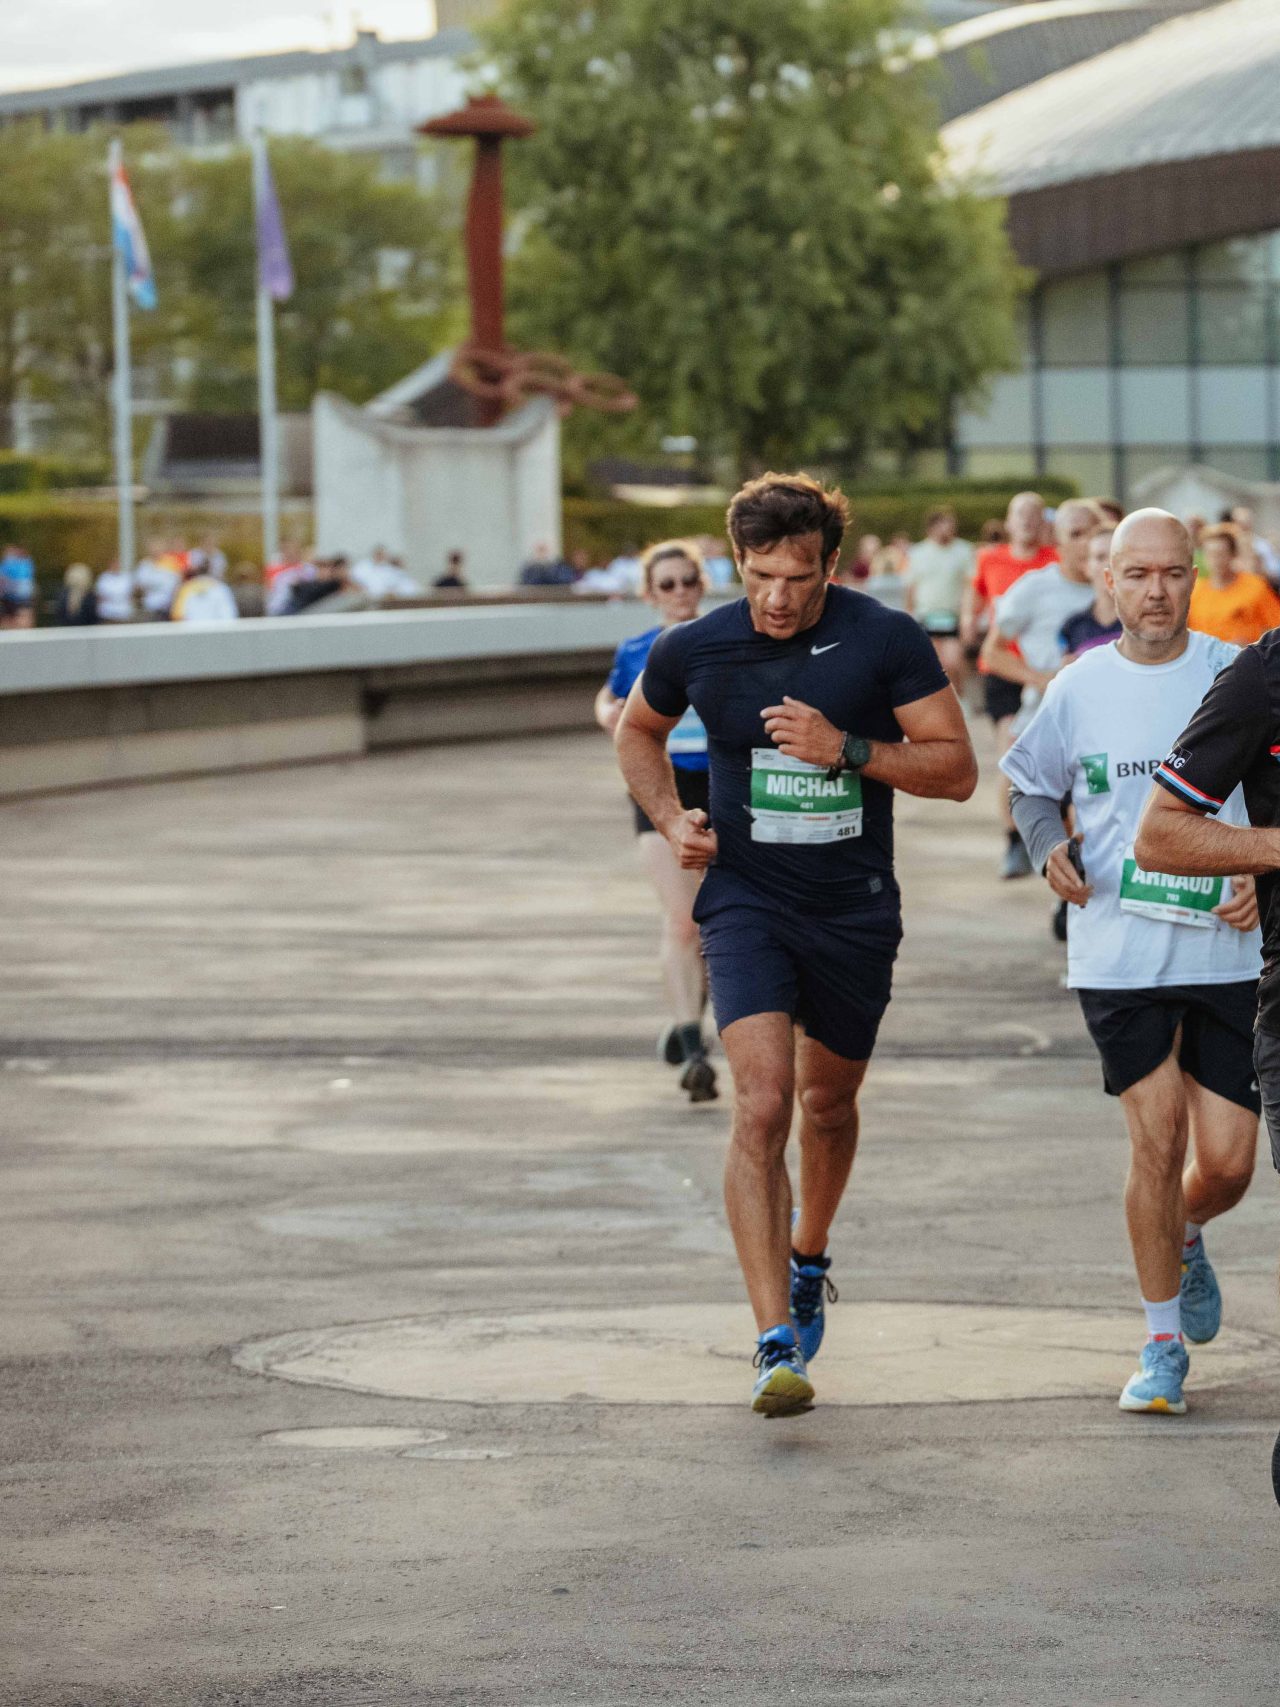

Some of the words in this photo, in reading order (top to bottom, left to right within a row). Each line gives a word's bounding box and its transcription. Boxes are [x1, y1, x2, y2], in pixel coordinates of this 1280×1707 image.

[1116, 760, 1161, 778] BNP
[766, 774, 849, 797] MICHAL
[837, 825, 856, 837] 481
[1131, 865, 1214, 895] ARNAUD
